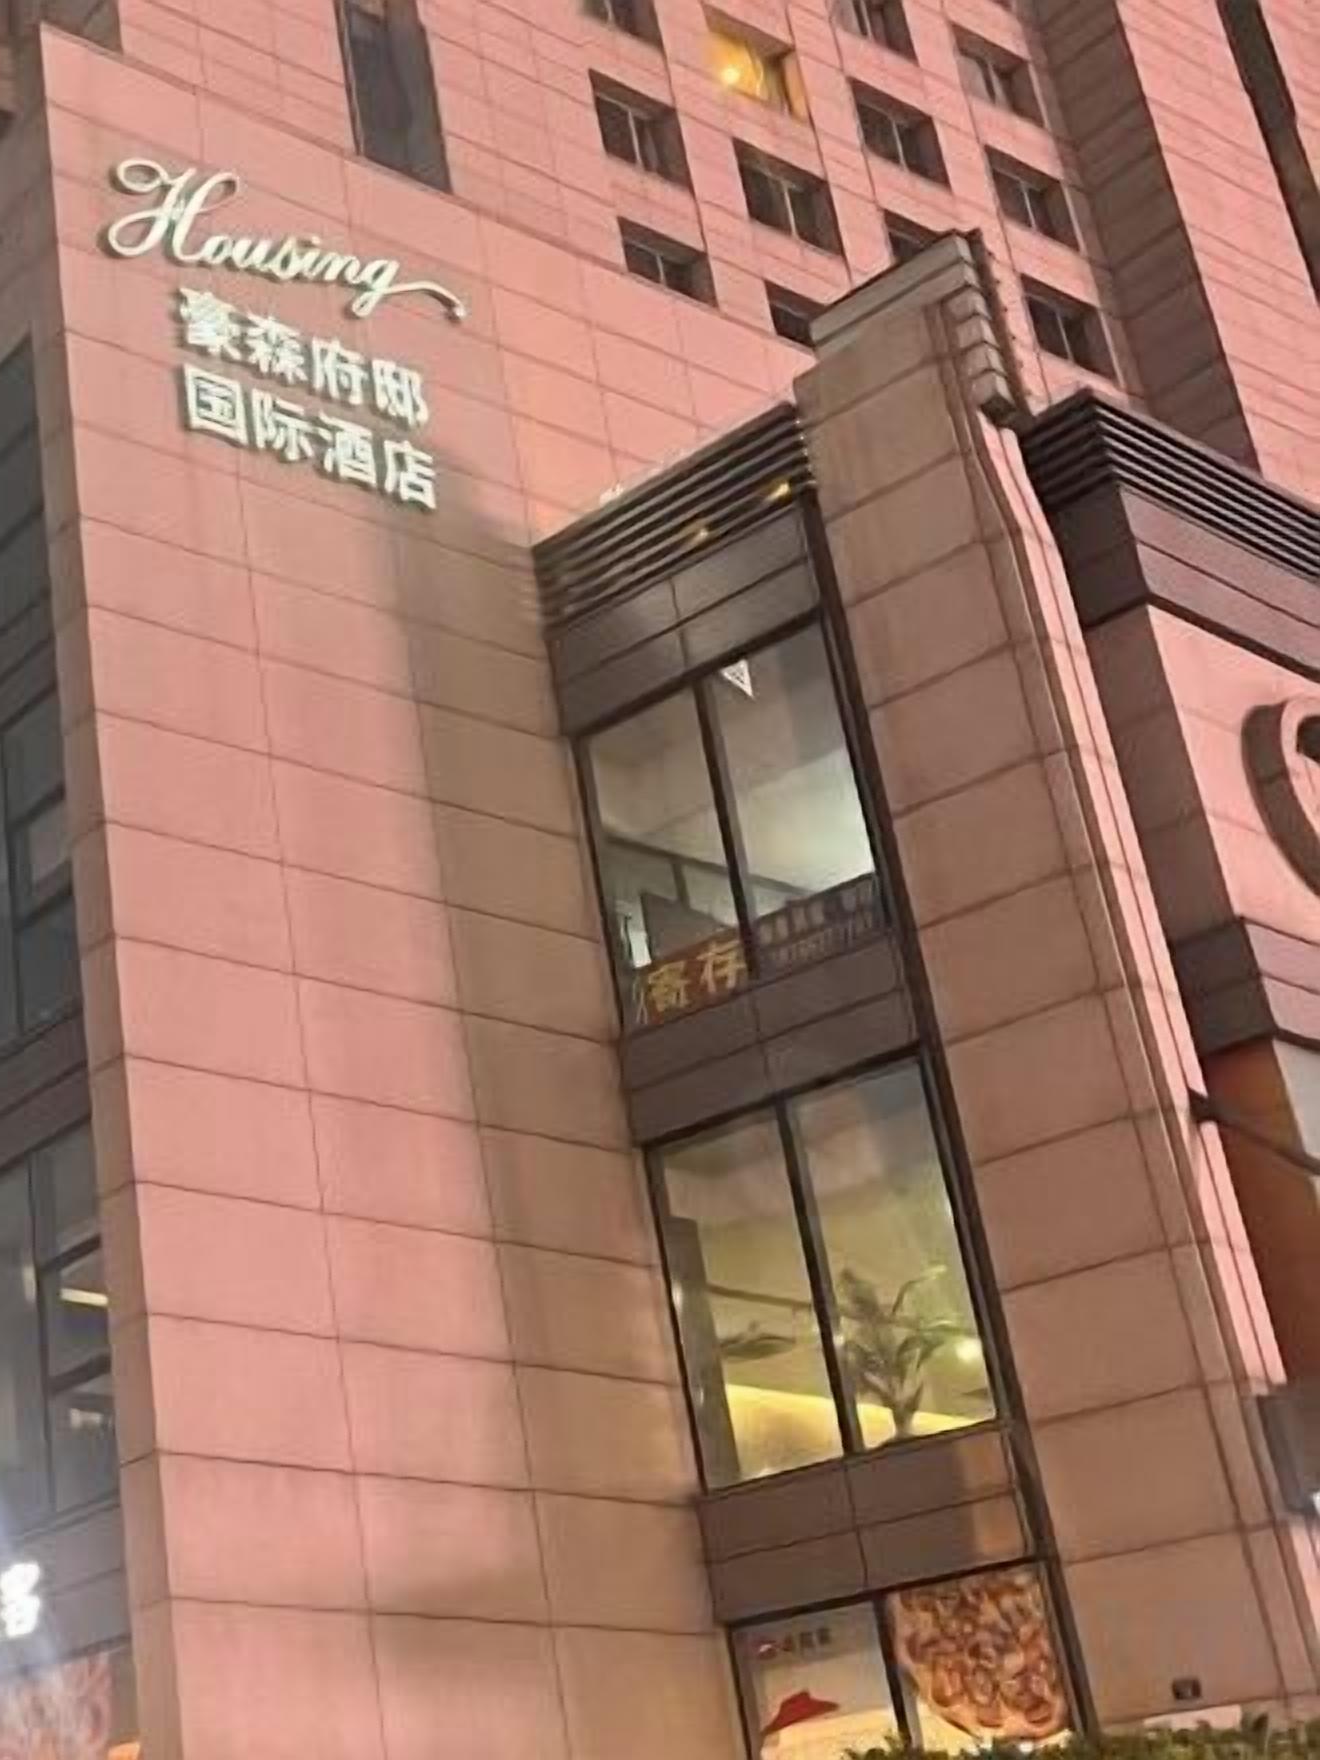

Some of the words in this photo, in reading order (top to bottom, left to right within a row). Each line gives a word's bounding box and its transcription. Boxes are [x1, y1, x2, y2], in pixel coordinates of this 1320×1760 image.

[107, 157, 467, 317] Housing
[179, 287, 429, 427] 豪森府邸
[183, 364, 437, 510] 国际酒店
